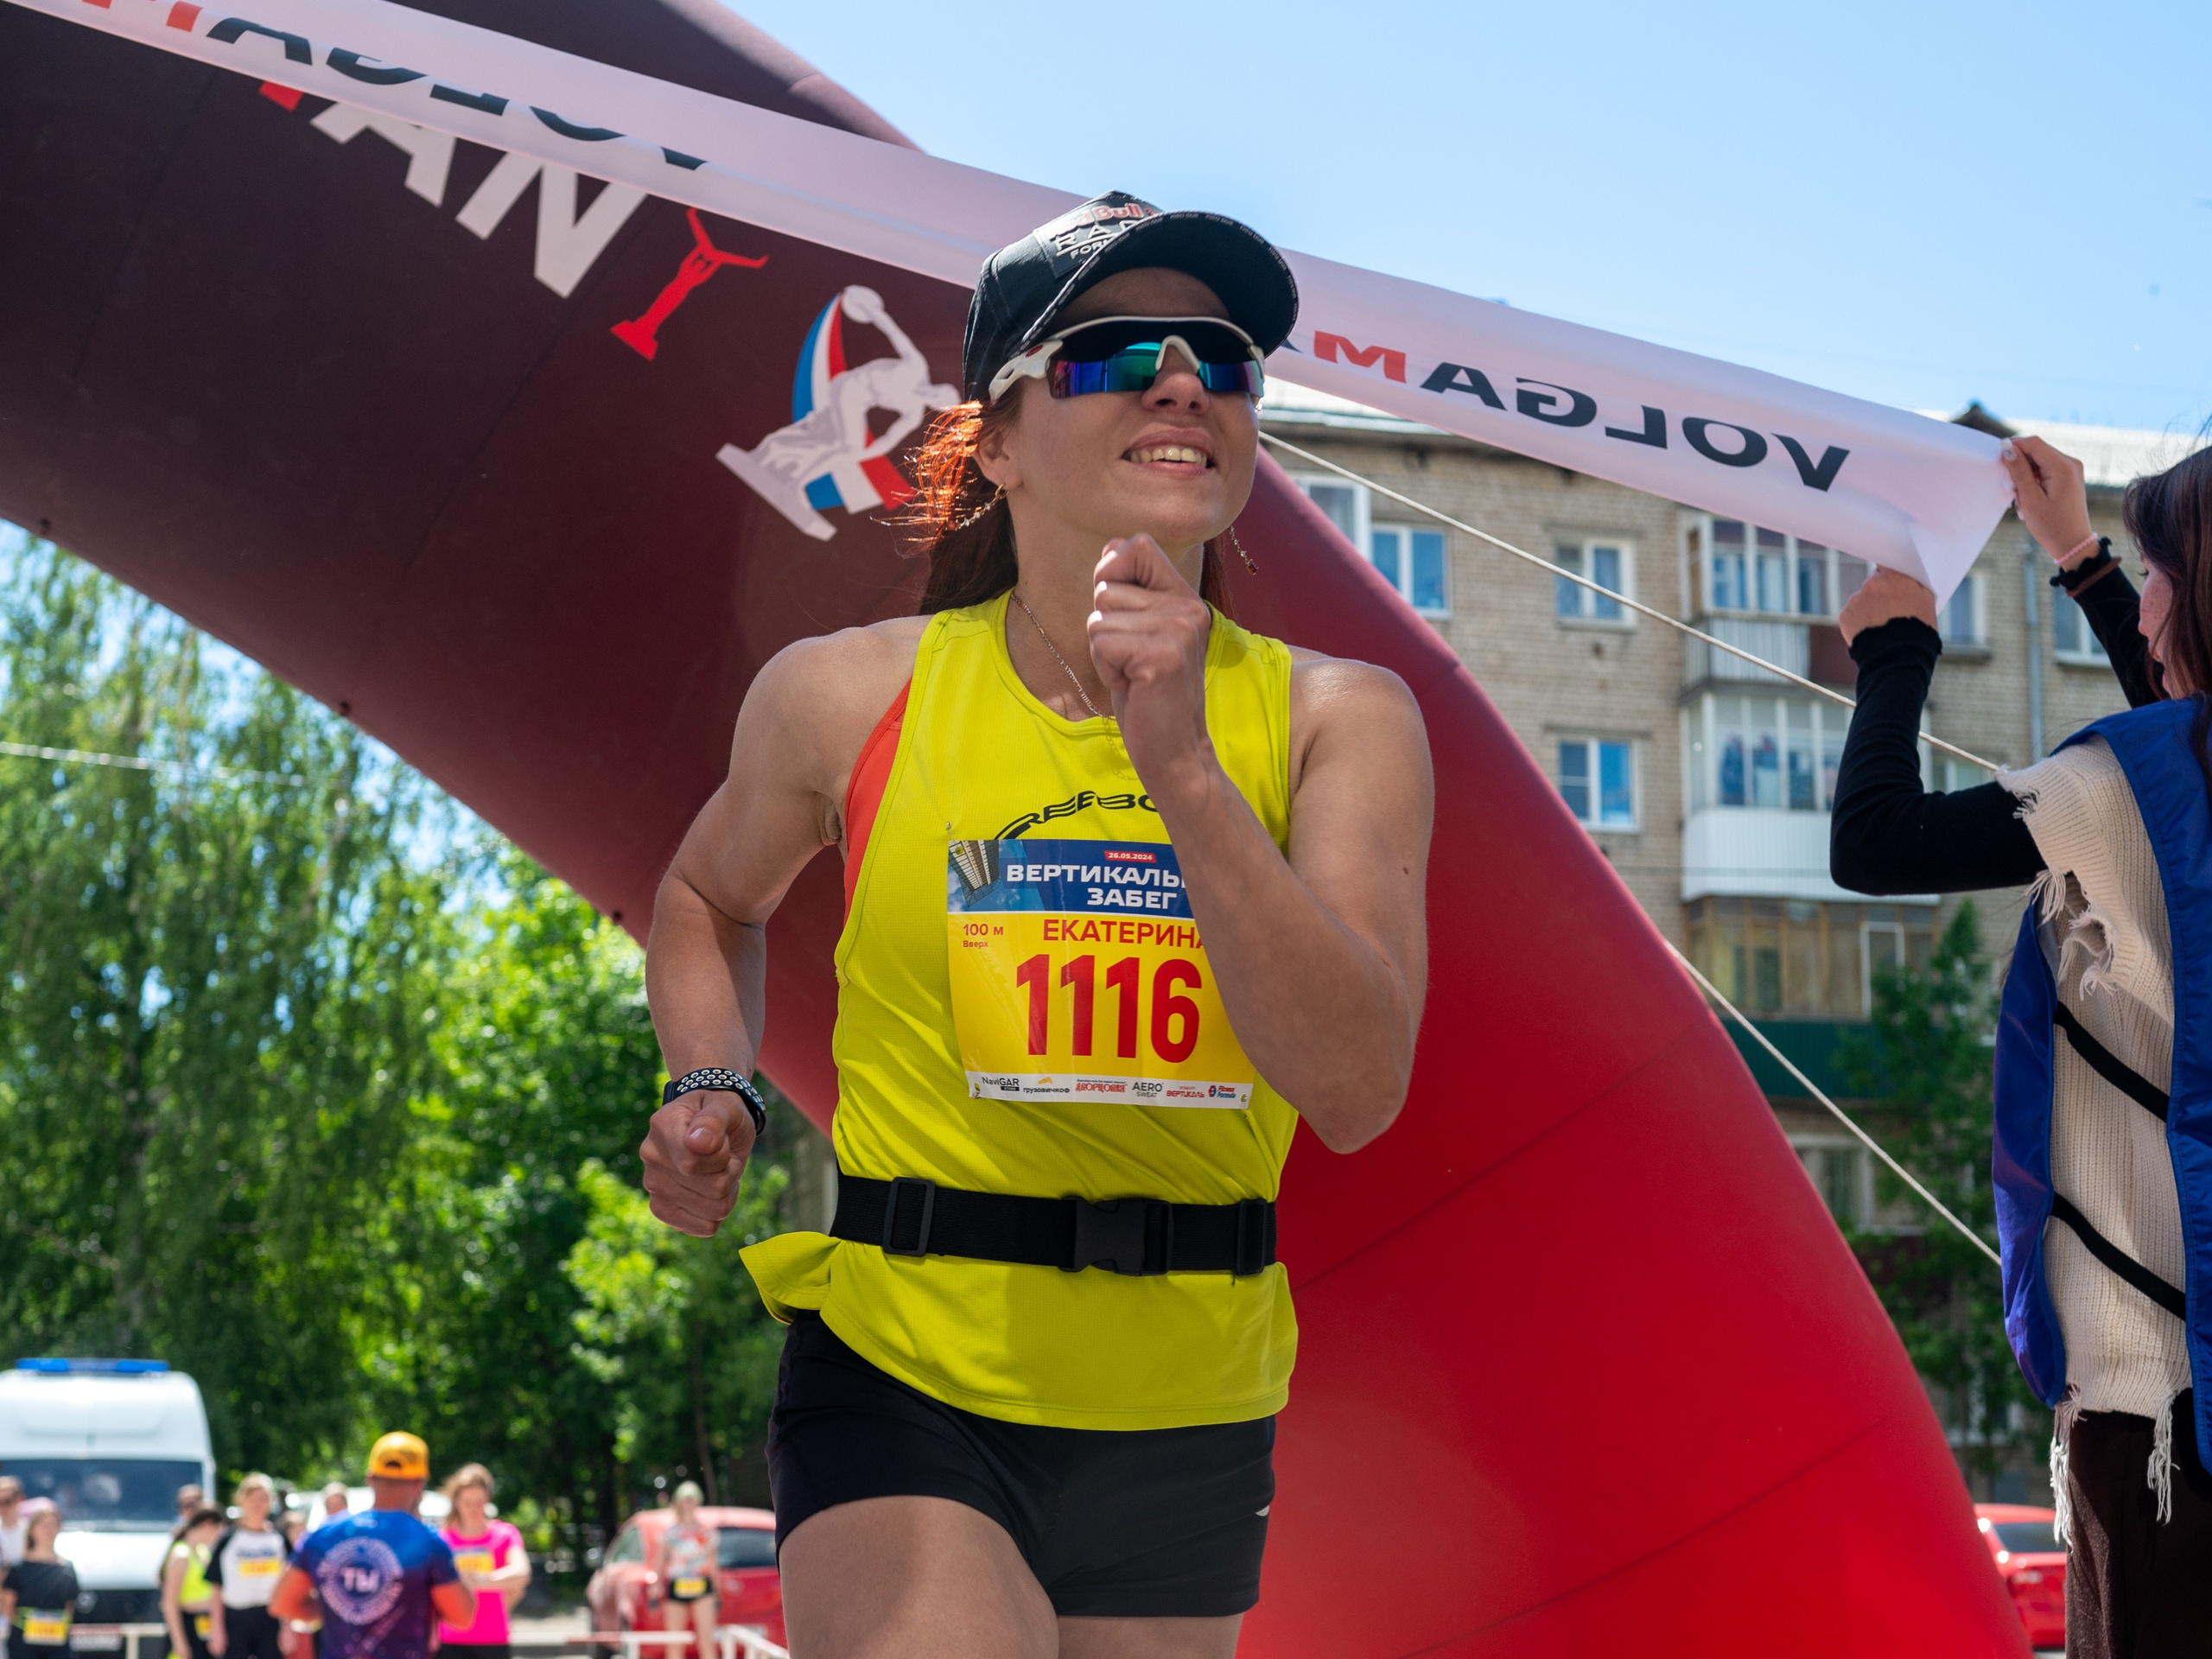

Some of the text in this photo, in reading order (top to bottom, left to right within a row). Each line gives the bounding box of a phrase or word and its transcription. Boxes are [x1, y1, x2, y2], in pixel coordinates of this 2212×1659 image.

[1091, 202, 1144, 221] Bull
[1108, 852, 1154, 861] 26.05.2024
[1007, 864, 1186, 889] ВЕРТИКАЛЬ
[1086, 887, 1178, 910] ЗАБЕГ
[963, 923, 988, 936] 100
[963, 940, 988, 949] Вверх
[1016, 953, 1202, 1064] 1116
[982, 1077, 1020, 1087] NaviGAR
[1132, 1082, 1163, 1092] AERO
